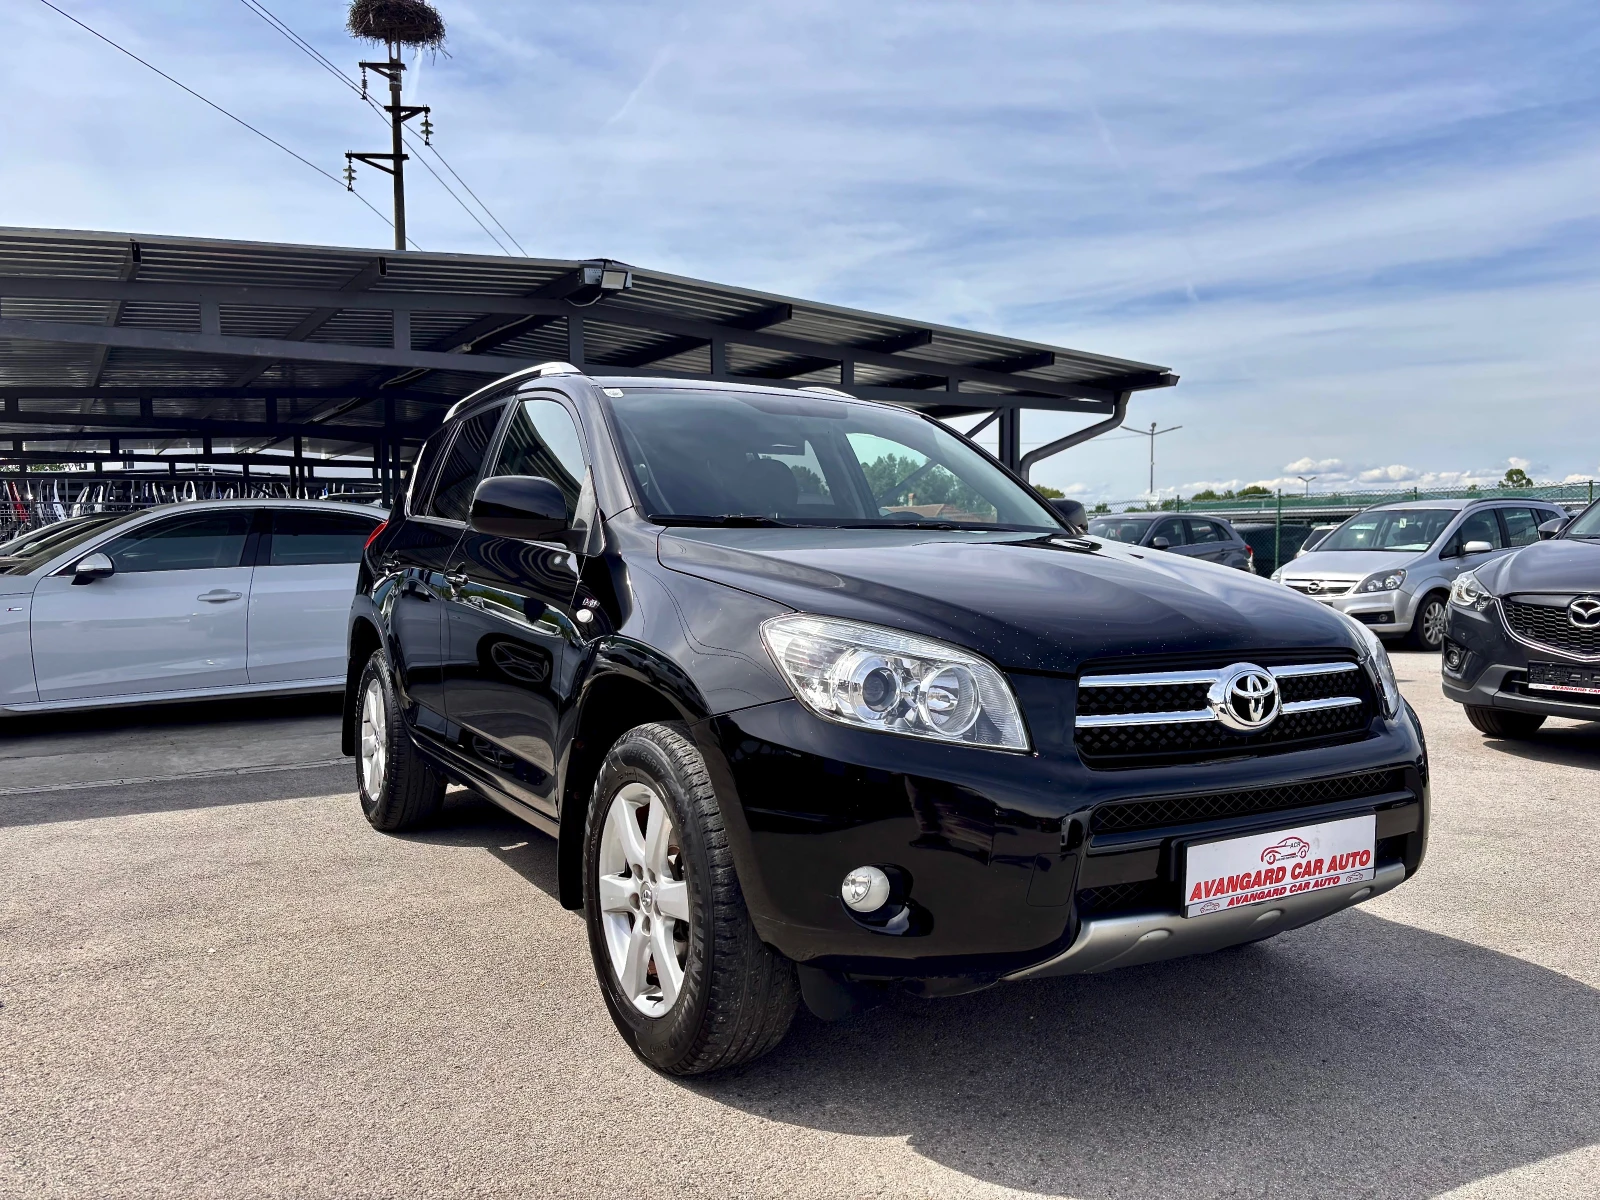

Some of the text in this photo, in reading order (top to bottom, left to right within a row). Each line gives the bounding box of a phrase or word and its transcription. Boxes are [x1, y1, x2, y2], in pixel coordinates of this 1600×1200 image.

[1189, 849, 1371, 901] AVANGARD CAR AUTO
[1227, 875, 1341, 907] AVANGARD CAR AUTO
